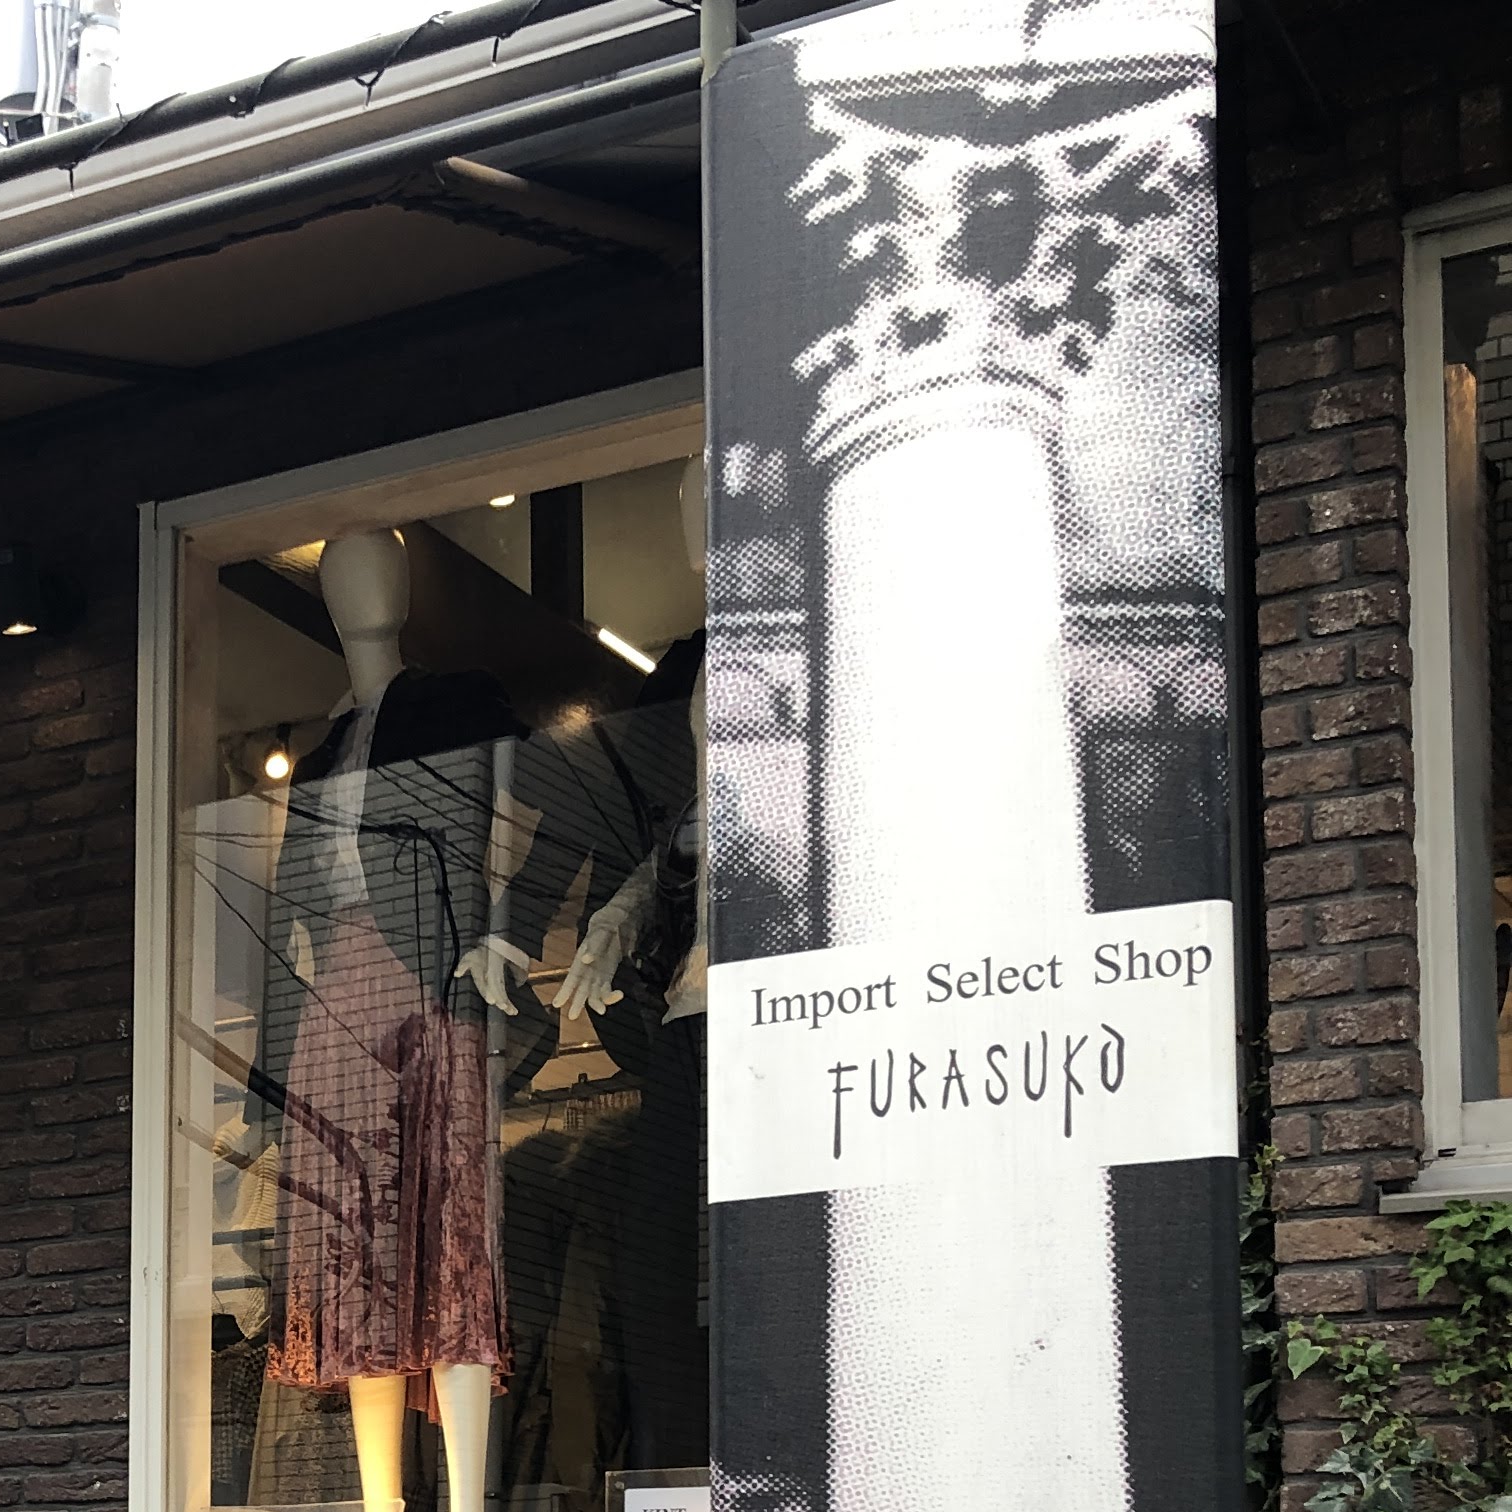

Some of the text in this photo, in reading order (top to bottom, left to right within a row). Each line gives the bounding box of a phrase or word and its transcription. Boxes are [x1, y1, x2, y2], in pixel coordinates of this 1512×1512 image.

[750, 940, 1214, 1031] Import Select Shop
[827, 1022, 1126, 1160] FURASUKO
